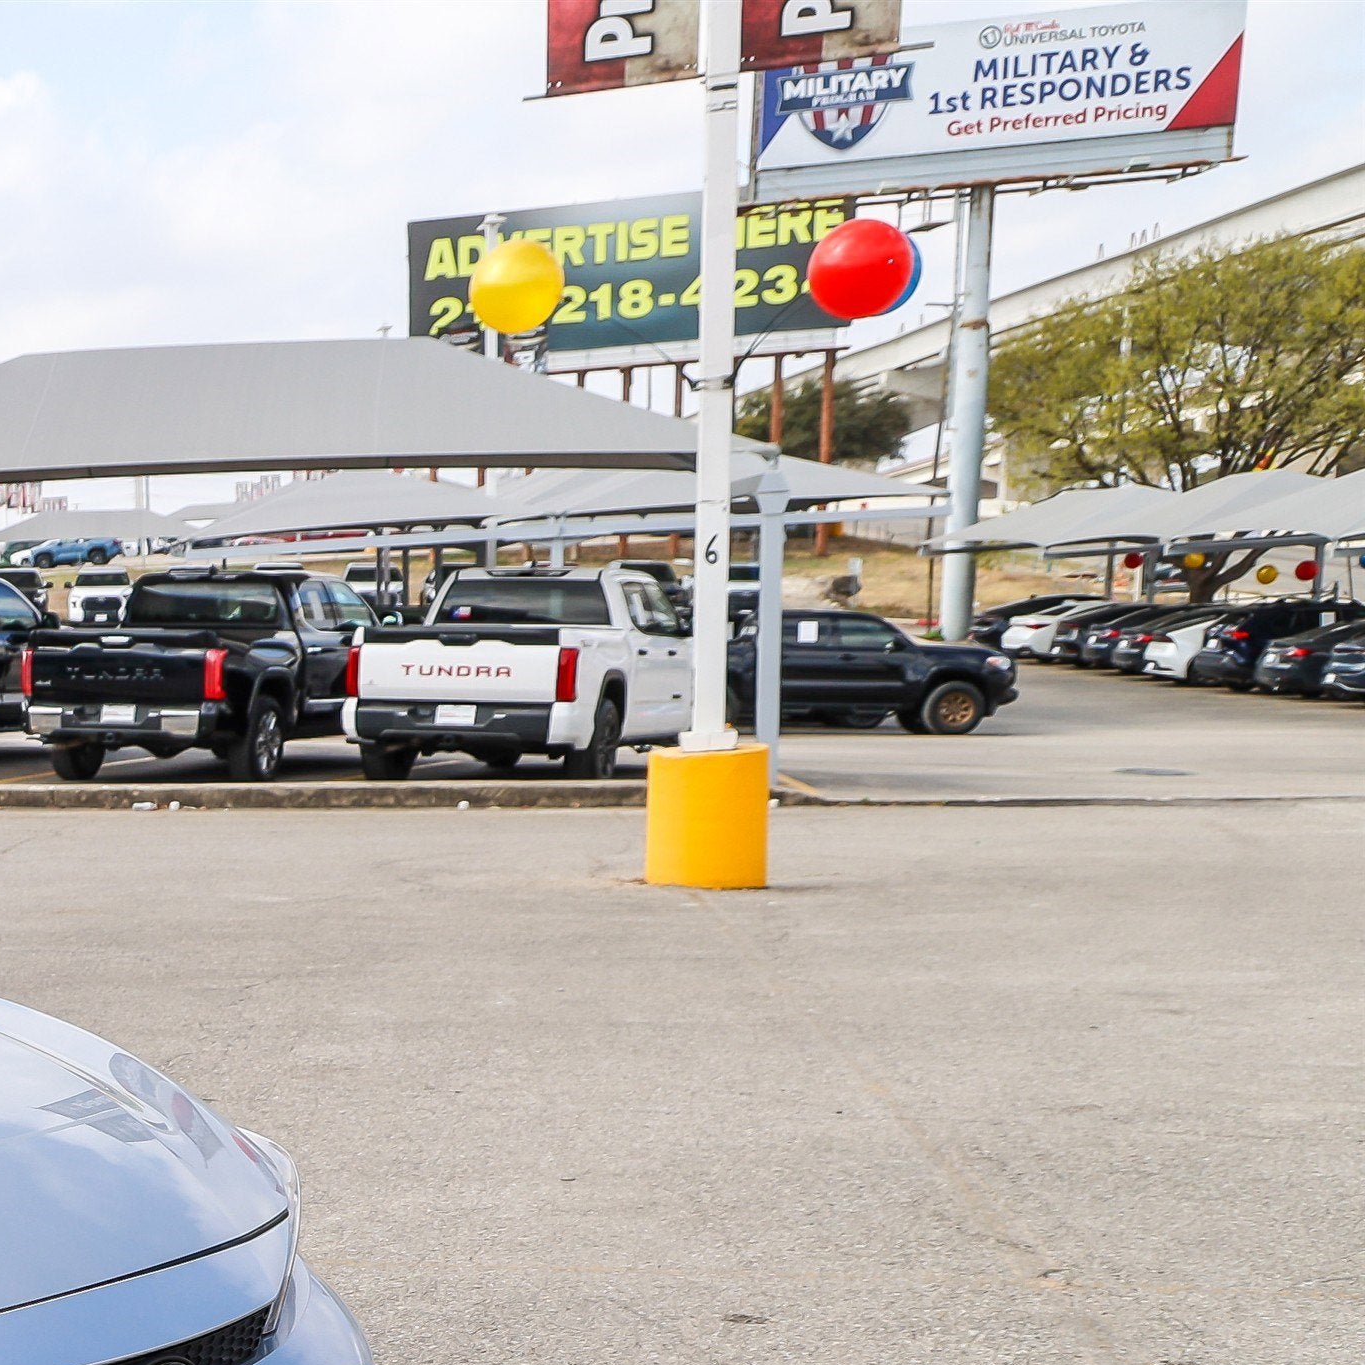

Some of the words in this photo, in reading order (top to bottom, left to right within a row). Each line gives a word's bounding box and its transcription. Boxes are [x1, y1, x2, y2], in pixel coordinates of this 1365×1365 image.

[1003, 27, 1086, 47] UNIVERSAL
[1089, 21, 1146, 37] TOYOTA
[973, 44, 1122, 82] MILITARY
[1129, 42, 1150, 66] &
[783, 67, 908, 101] MILITARY
[928, 91, 970, 114] 1st
[980, 66, 1192, 109] RESPONDERS
[947, 117, 982, 137] Get
[989, 107, 1087, 134] Preferred
[1094, 101, 1168, 124] Pricing
[424, 215, 690, 281] ADRTISE
[705, 533, 718, 565] 6
[401, 664, 513, 678] TUNDRA
